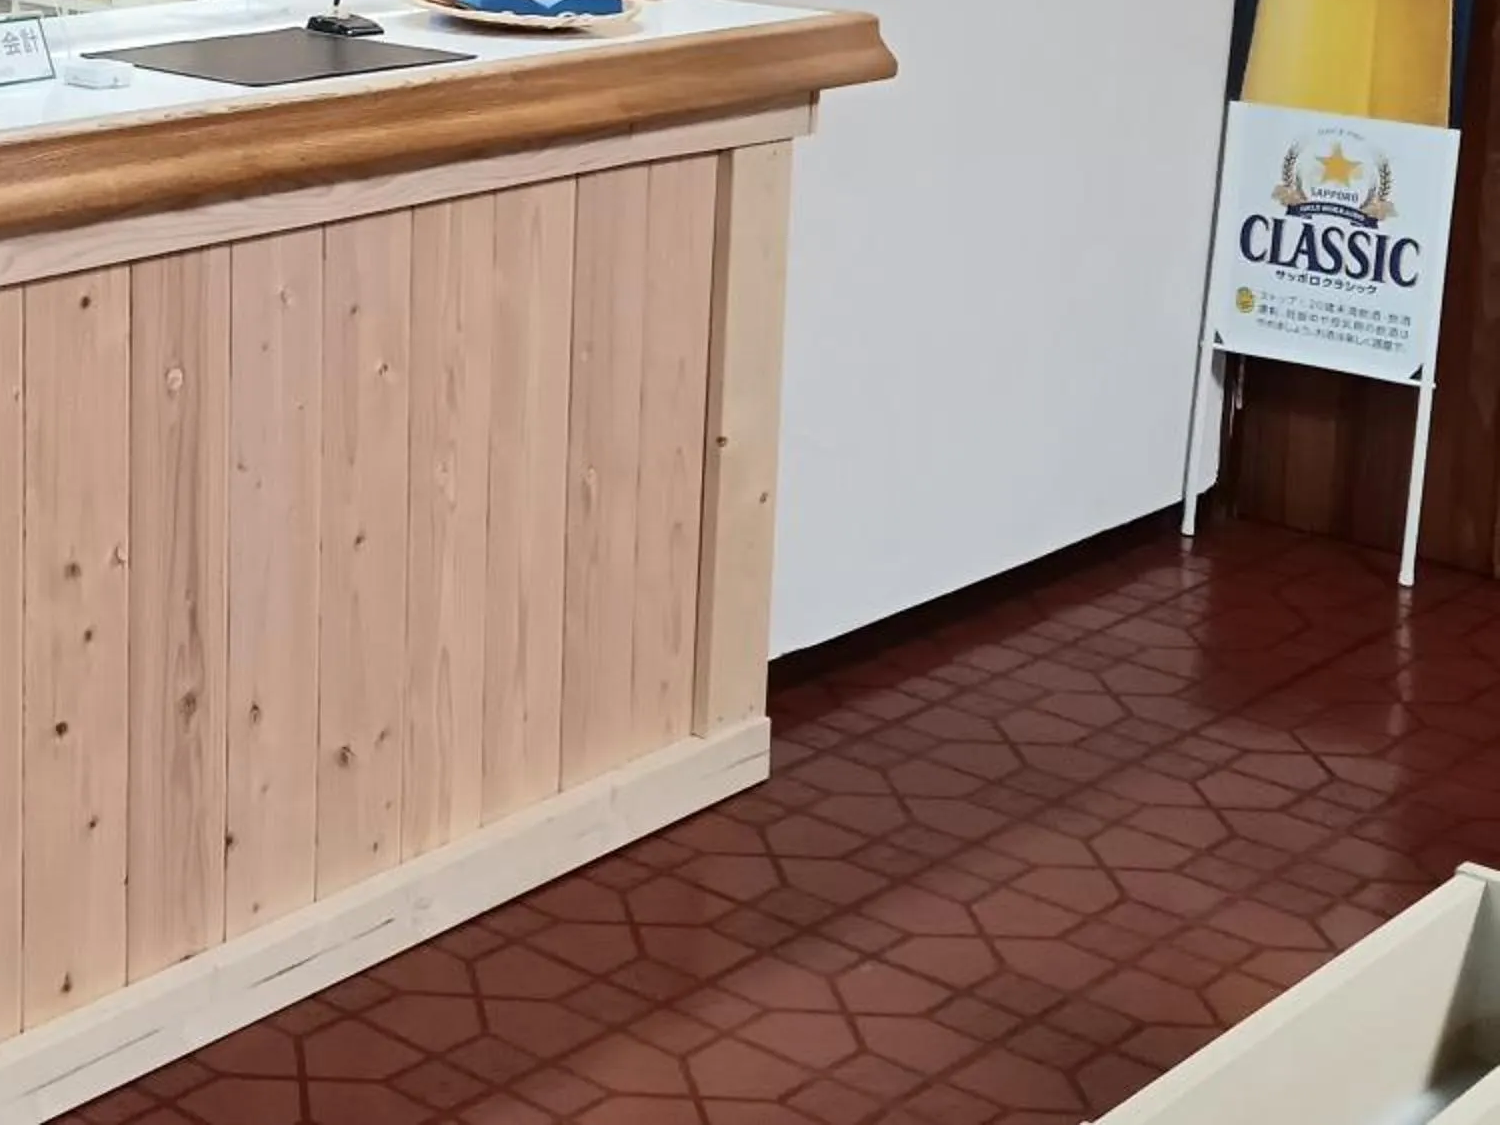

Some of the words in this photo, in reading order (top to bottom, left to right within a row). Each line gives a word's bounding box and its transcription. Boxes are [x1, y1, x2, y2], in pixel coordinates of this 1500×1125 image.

[1310, 186, 1360, 203] SAPPORO
[1239, 214, 1421, 287] CLASSIC
[1275, 270, 1377, 294] サッポロクラシック
